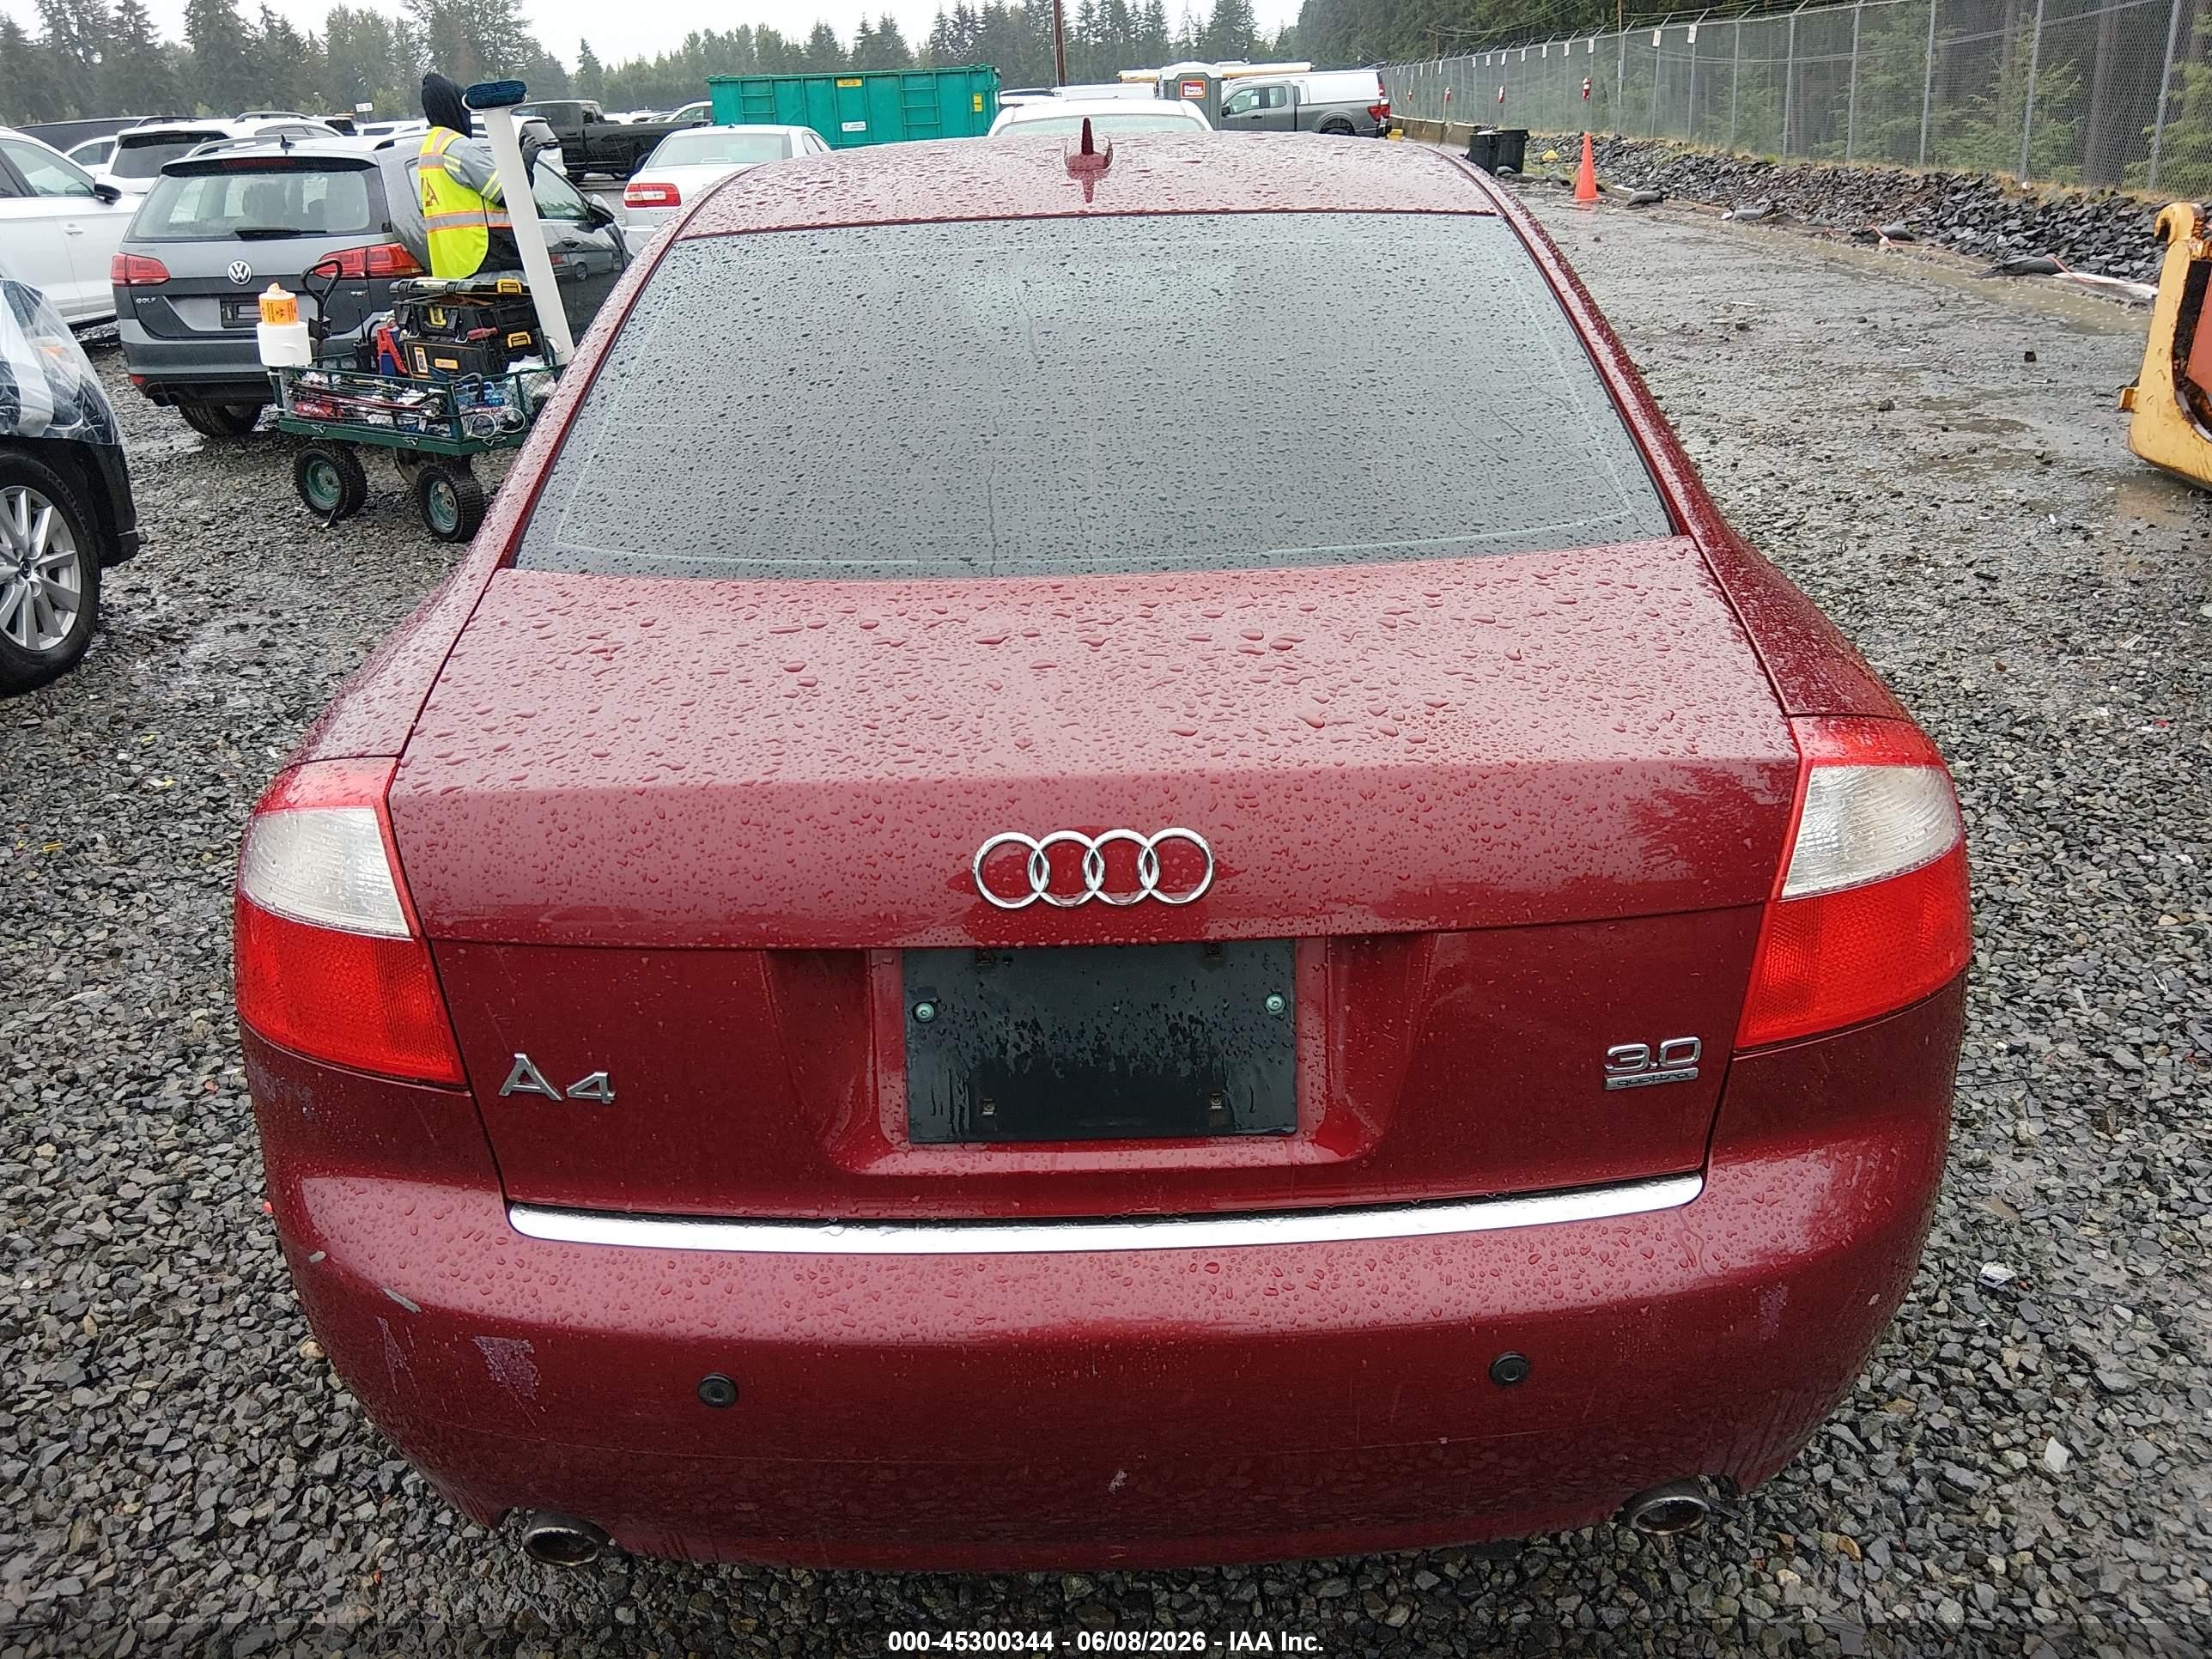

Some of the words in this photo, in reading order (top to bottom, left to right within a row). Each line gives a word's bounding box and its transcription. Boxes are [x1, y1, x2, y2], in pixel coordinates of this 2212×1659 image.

[228, 260, 252, 285] VW
[1605, 1036, 1701, 1073] 3.0
[499, 1053, 617, 1104] A4
[1616, 1072, 1690, 1086] quattro
